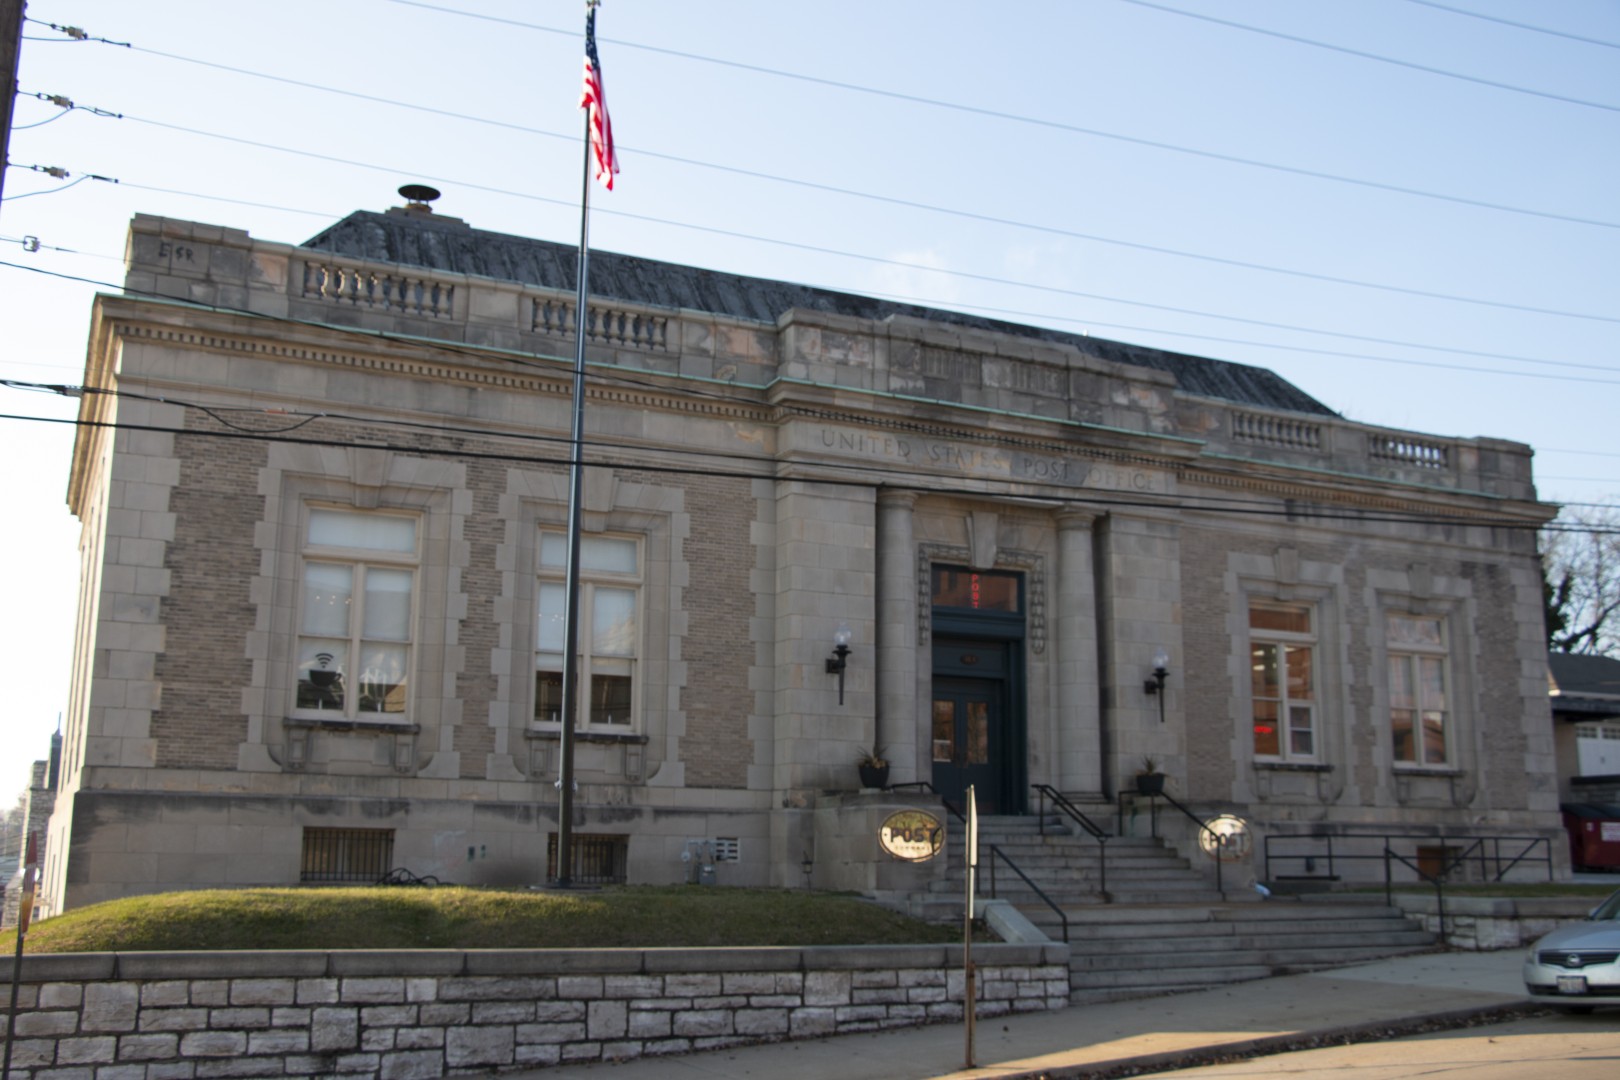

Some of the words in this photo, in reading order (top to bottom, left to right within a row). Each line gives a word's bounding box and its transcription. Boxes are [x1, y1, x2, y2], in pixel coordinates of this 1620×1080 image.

[821, 429, 912, 458] UNITED
[928, 444, 1003, 470] STATES
[1023, 457, 1071, 480] POST
[1088, 466, 1155, 491] OFFICE
[971, 573, 980, 609] POST
[890, 826, 936, 844] POST
